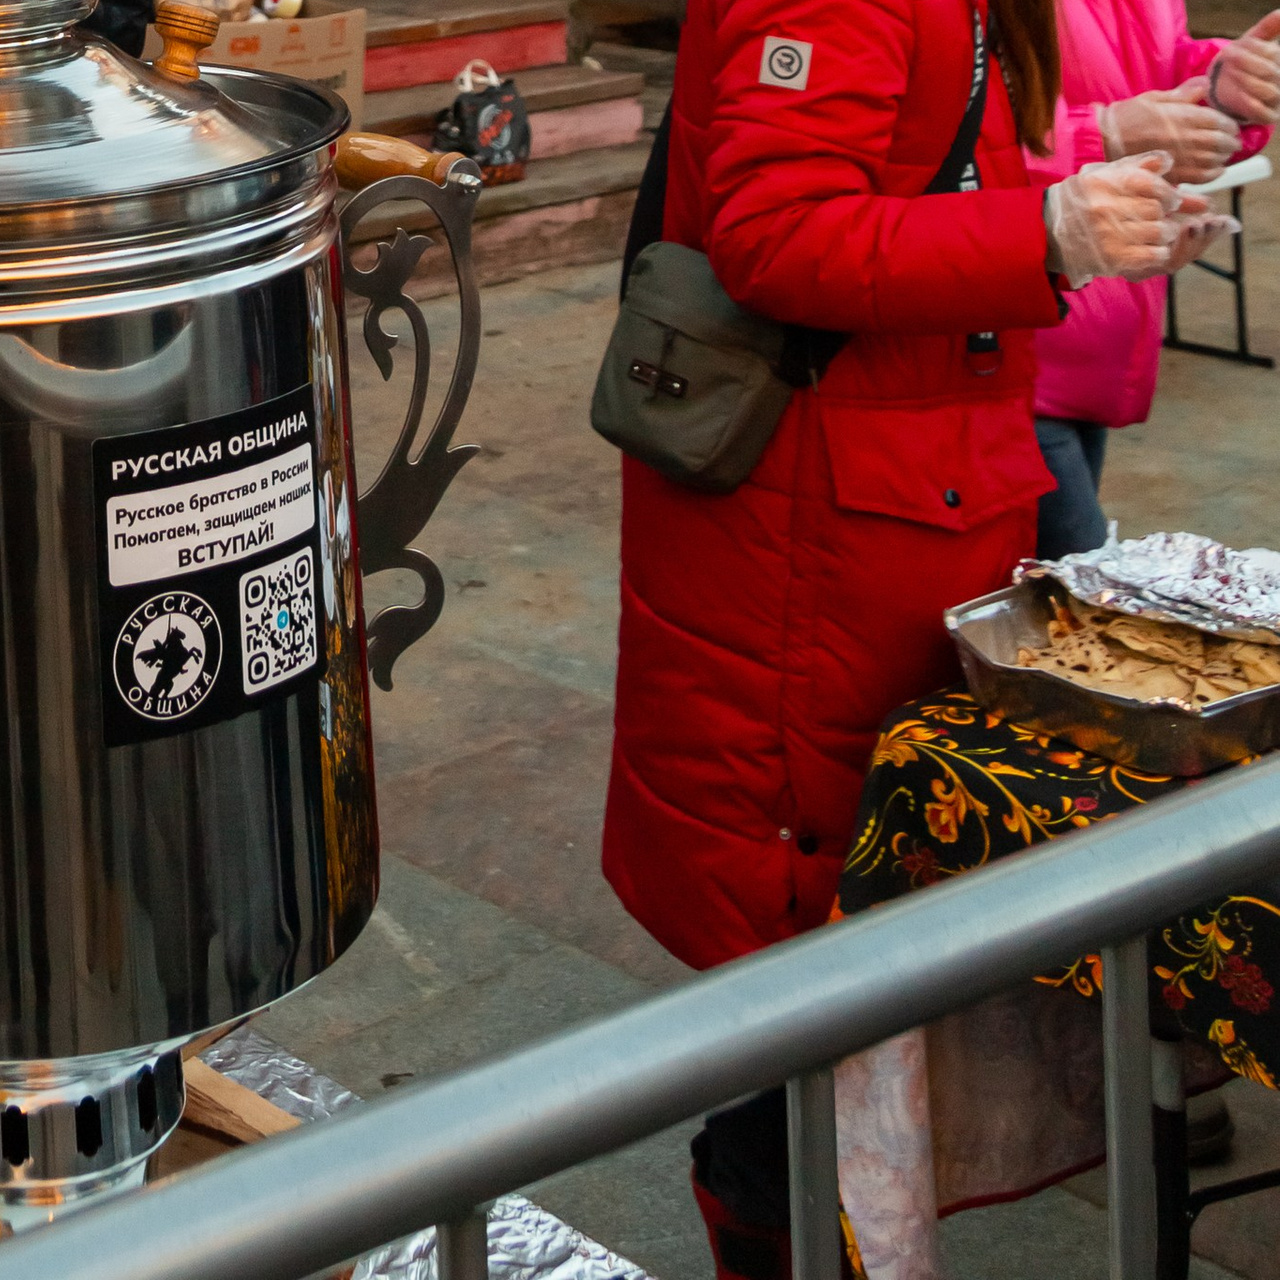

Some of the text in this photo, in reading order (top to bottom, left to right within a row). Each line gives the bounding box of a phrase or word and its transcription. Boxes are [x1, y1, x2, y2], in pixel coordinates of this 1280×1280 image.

[111, 410, 308, 481] РУССКАЯ ОБЩИНА
[113, 480, 312, 550] Помогаем, защищаем наших
[115, 458, 310, 525] Русское братство в России
[177, 521, 275, 568] ВСТУПАЙ!
[122, 595, 214, 645] РУССКАЯ
[127, 669, 213, 717] ОБЩИНА
